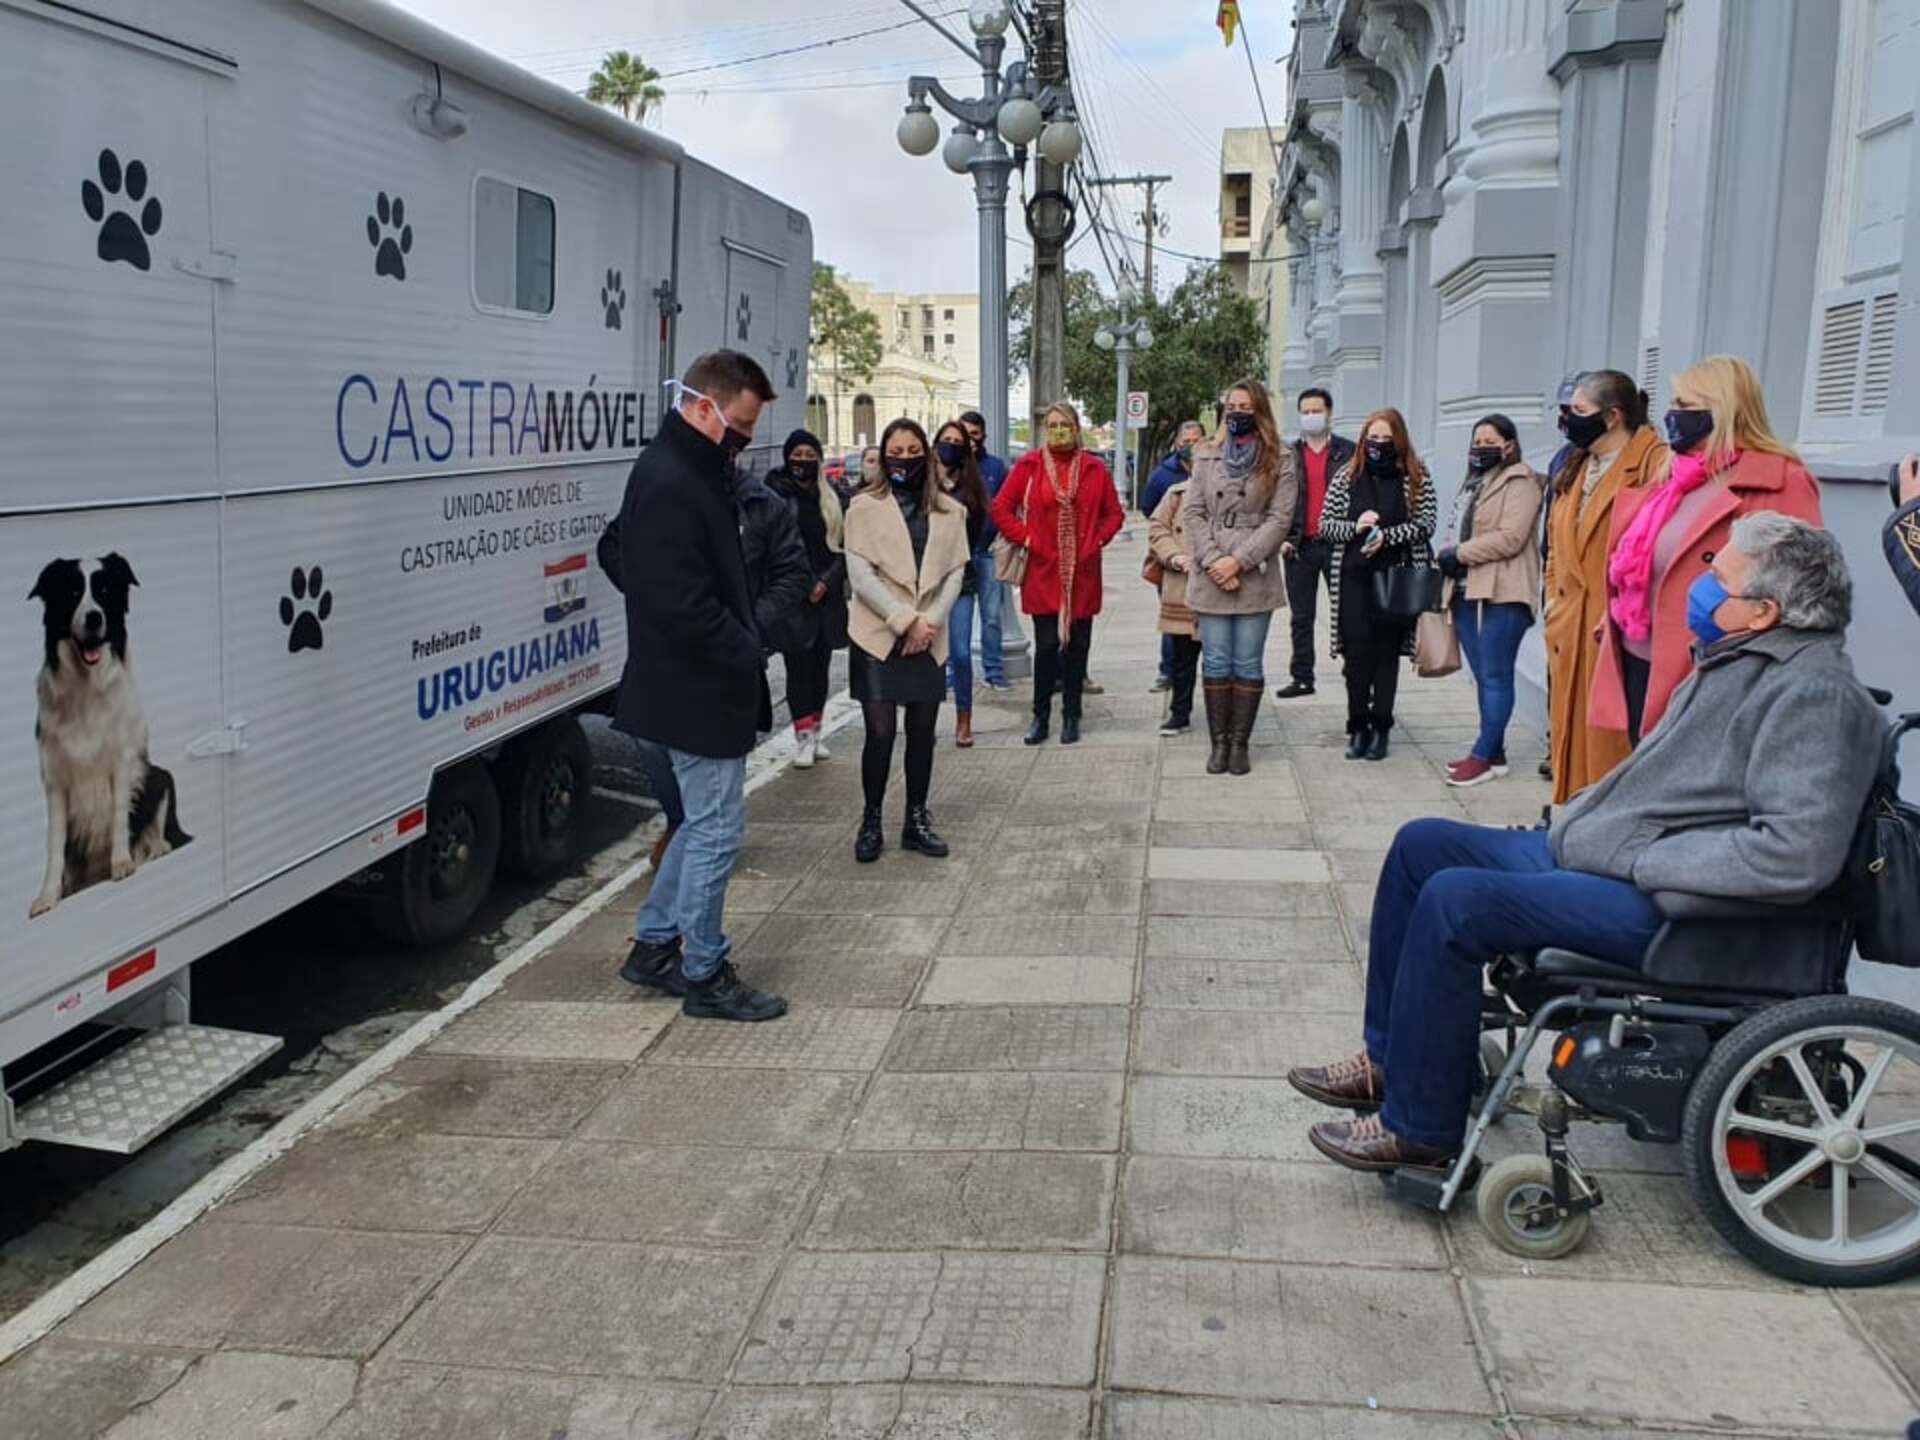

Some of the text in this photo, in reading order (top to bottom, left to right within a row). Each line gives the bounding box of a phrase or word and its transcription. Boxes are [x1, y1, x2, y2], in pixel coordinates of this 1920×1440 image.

[337, 373, 654, 468] CASTRAMÓVEL
[443, 481, 583, 521] UNIDADE MÓVEL DE
[401, 513, 608, 573] CASTRAÇÃO DE CÃES E GATOS
[412, 621, 481, 660] Prefeitura de
[418, 617, 600, 720] URUGUAIANA
